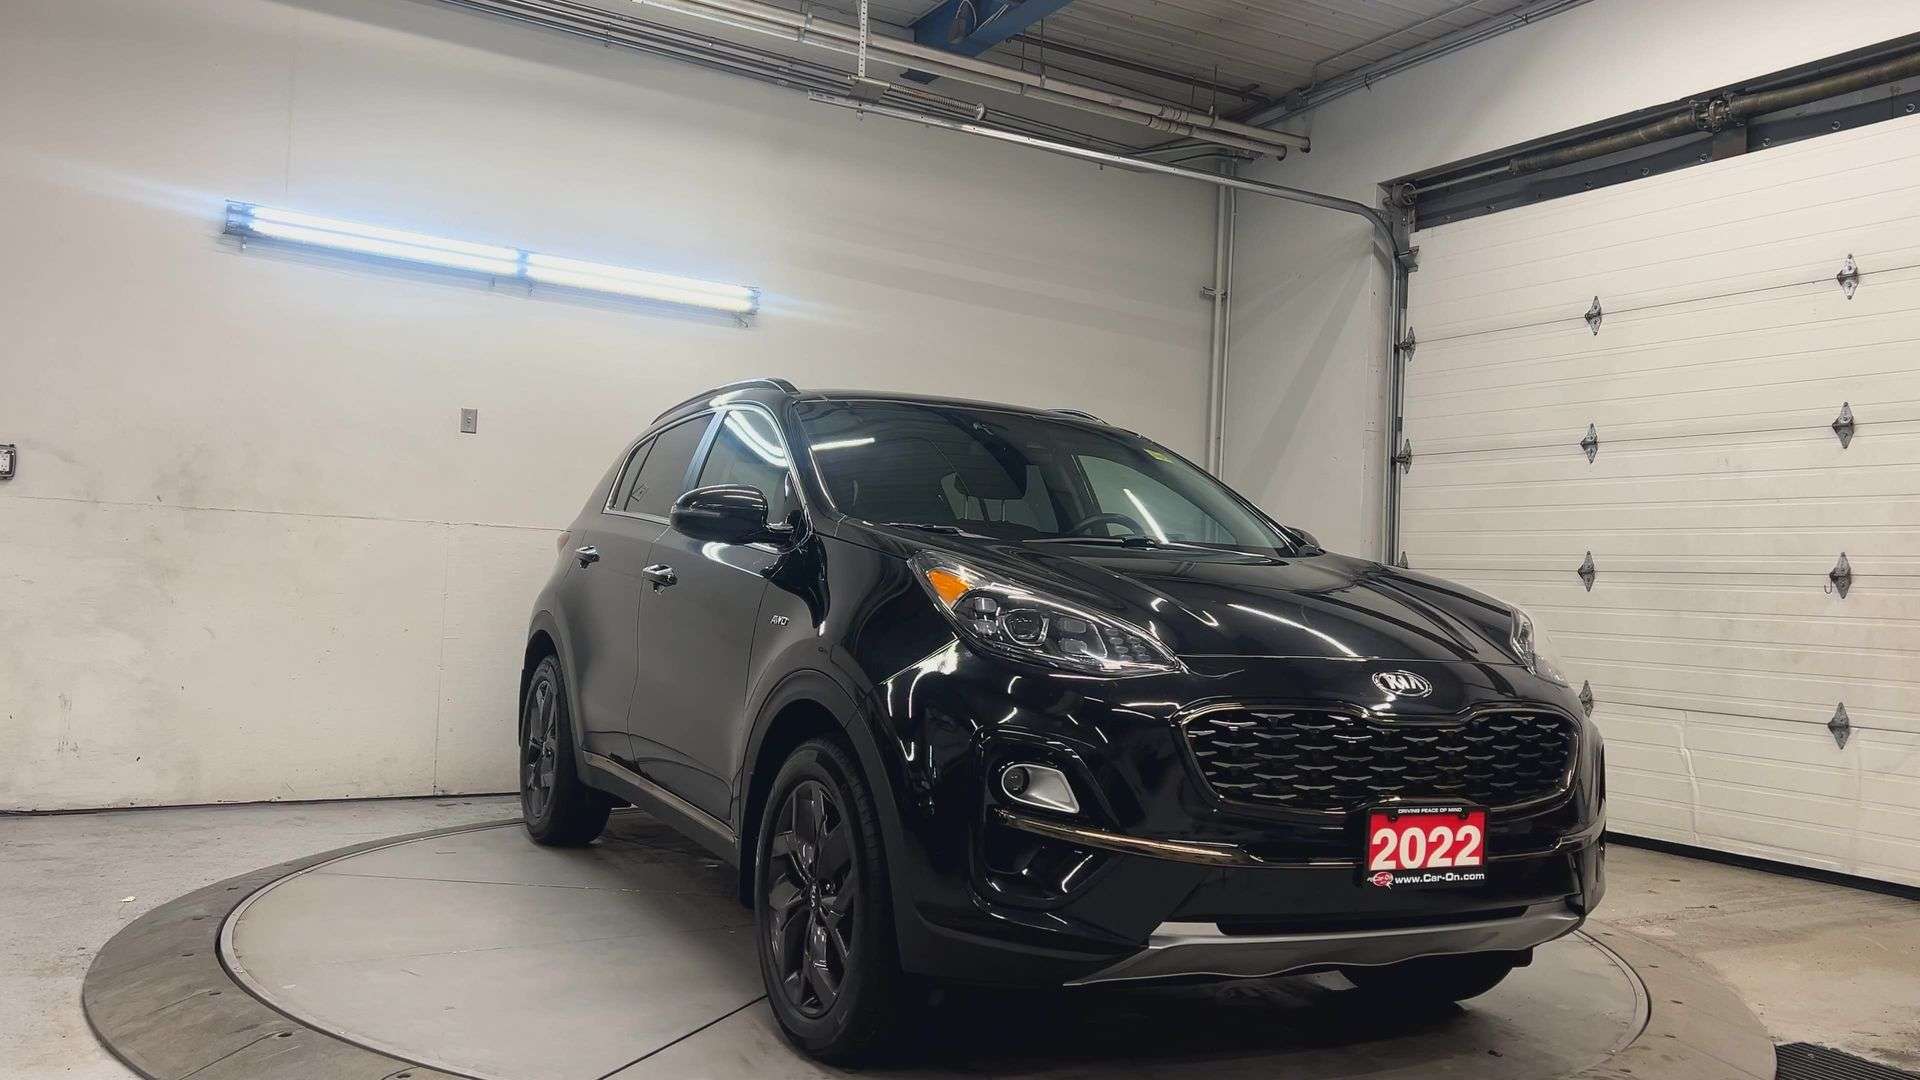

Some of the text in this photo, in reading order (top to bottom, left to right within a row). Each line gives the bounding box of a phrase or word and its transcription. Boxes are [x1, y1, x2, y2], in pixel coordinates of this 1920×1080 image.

[770, 615, 790, 626] AWD
[1382, 672, 1426, 691] KIA
[1370, 825, 1481, 870] 2022
[1395, 872, 1485, 884] www.Car-On.com
